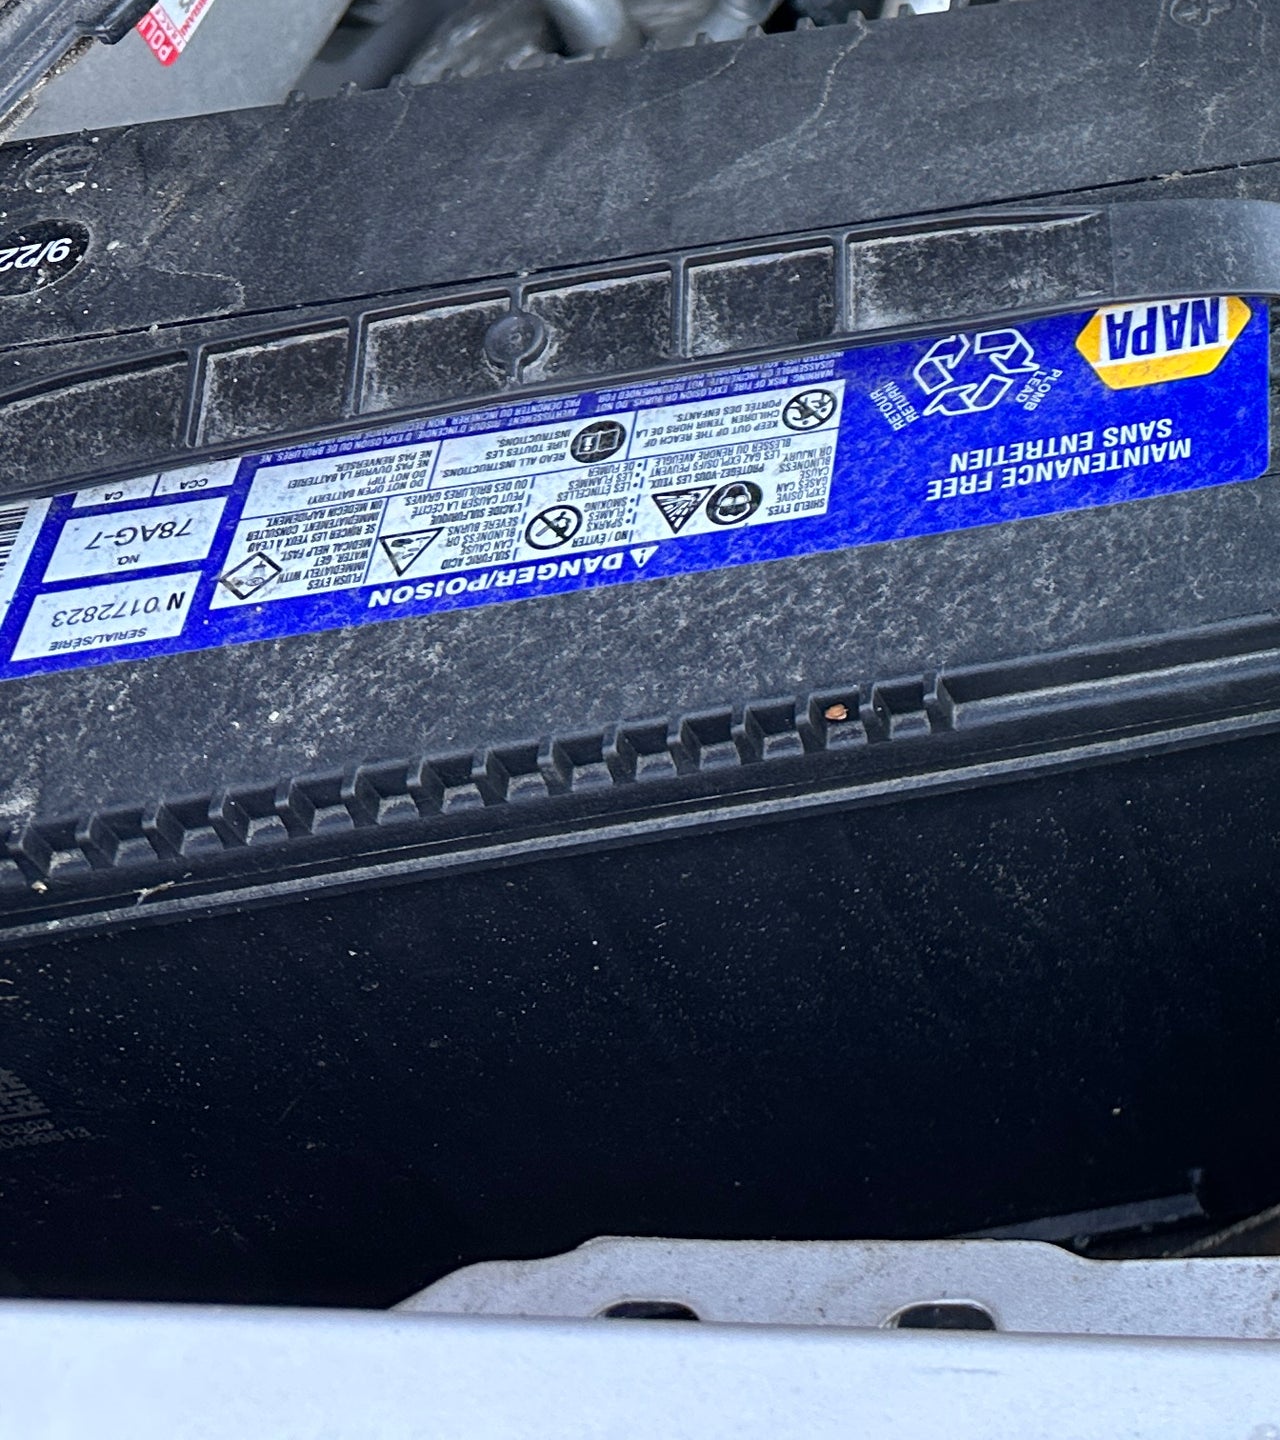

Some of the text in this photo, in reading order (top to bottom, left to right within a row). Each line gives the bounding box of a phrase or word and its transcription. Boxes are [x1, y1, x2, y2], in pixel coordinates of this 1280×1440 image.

[1109, 295, 1219, 360] NAPA
[1014, 368, 1046, 404] LEAD
[1020, 366, 1063, 411] PLOMB
[724, 403, 742, 414] DES
[883, 379, 918, 423] RETURN
[868, 387, 905, 431] RETOUR
[635, 417, 724, 439] TENIR HORS DE LA
[642, 419, 777, 448] KEEP OUT OF THE REACH OF
[485, 439, 568, 460] LIRE TOUTES LES
[735, 443, 748, 455] OU
[751, 437, 791, 452] BLESSER
[819, 445, 832, 456] OR
[949, 416, 1171, 473] SANS ENTRETIEN
[398, 451, 417, 462] PAS
[419, 449, 432, 459] NE
[519, 451, 565, 466] READ ALL
[699, 446, 733, 460] RENDRE
[394, 460, 413, 471] PAS
[416, 458, 429, 468] NE
[587, 460, 635, 477] DE FUMER
[649, 449, 780, 478] LES GAZ EXPLOSIFS PEUVENT
[779, 455, 830, 472] BLINDNESS
[926, 437, 1190, 501] MAINTENANCE FREE
[339, 470, 352, 480] LA
[353, 464, 391, 478] OUVRIR
[388, 471, 408, 482] NOT
[411, 469, 426, 479] DO
[676, 473, 691, 484] LES
[800, 465, 829, 479] CAUSE
[180, 476, 207, 490] CCA
[386, 481, 406, 491] NOT
[409, 478, 423, 488] DO
[495, 480, 509, 492] DES
[512, 478, 527, 489] OU
[568, 471, 633, 490] LES FLAMMES
[614, 480, 630, 492] LES
[775, 475, 828, 493] GASES CAN
[104, 489, 122, 501] CA
[356, 484, 384, 496] OPEN
[776, 485, 826, 503] EXPLOSIVE
[371, 499, 382, 510] UN
[446, 489, 524, 511] PEUT CAUSER LA
[583, 495, 626, 513] SMOKING
[766, 497, 824, 516] SHIELD EYES.
[589, 506, 624, 521] FLAMES
[364, 522, 375, 534] SE
[483, 515, 518, 530] SEVERE
[585, 516, 623, 531] SPARKS
[84, 517, 192, 551] 78AG-7
[286, 533, 308, 546] YEUX
[310, 530, 327, 542] LES
[445, 526, 515, 547] BLINDNESS OR
[306, 543, 329, 557] HELP
[332, 537, 372, 552] MEDICAL
[461, 537, 513, 555] CAN CAUSE
[312, 554, 332, 567] GET
[440, 548, 510, 569] SULFURIC ACID
[276, 560, 365, 584] IMMEDIATELY WITH
[367, 550, 622, 609] DANGER/POISON
[306, 571, 362, 590] FLUSH EYES
[51, 590, 185, 627] N 0172823
[48, 626, 146, 652] SERIAL/SÉRIE
